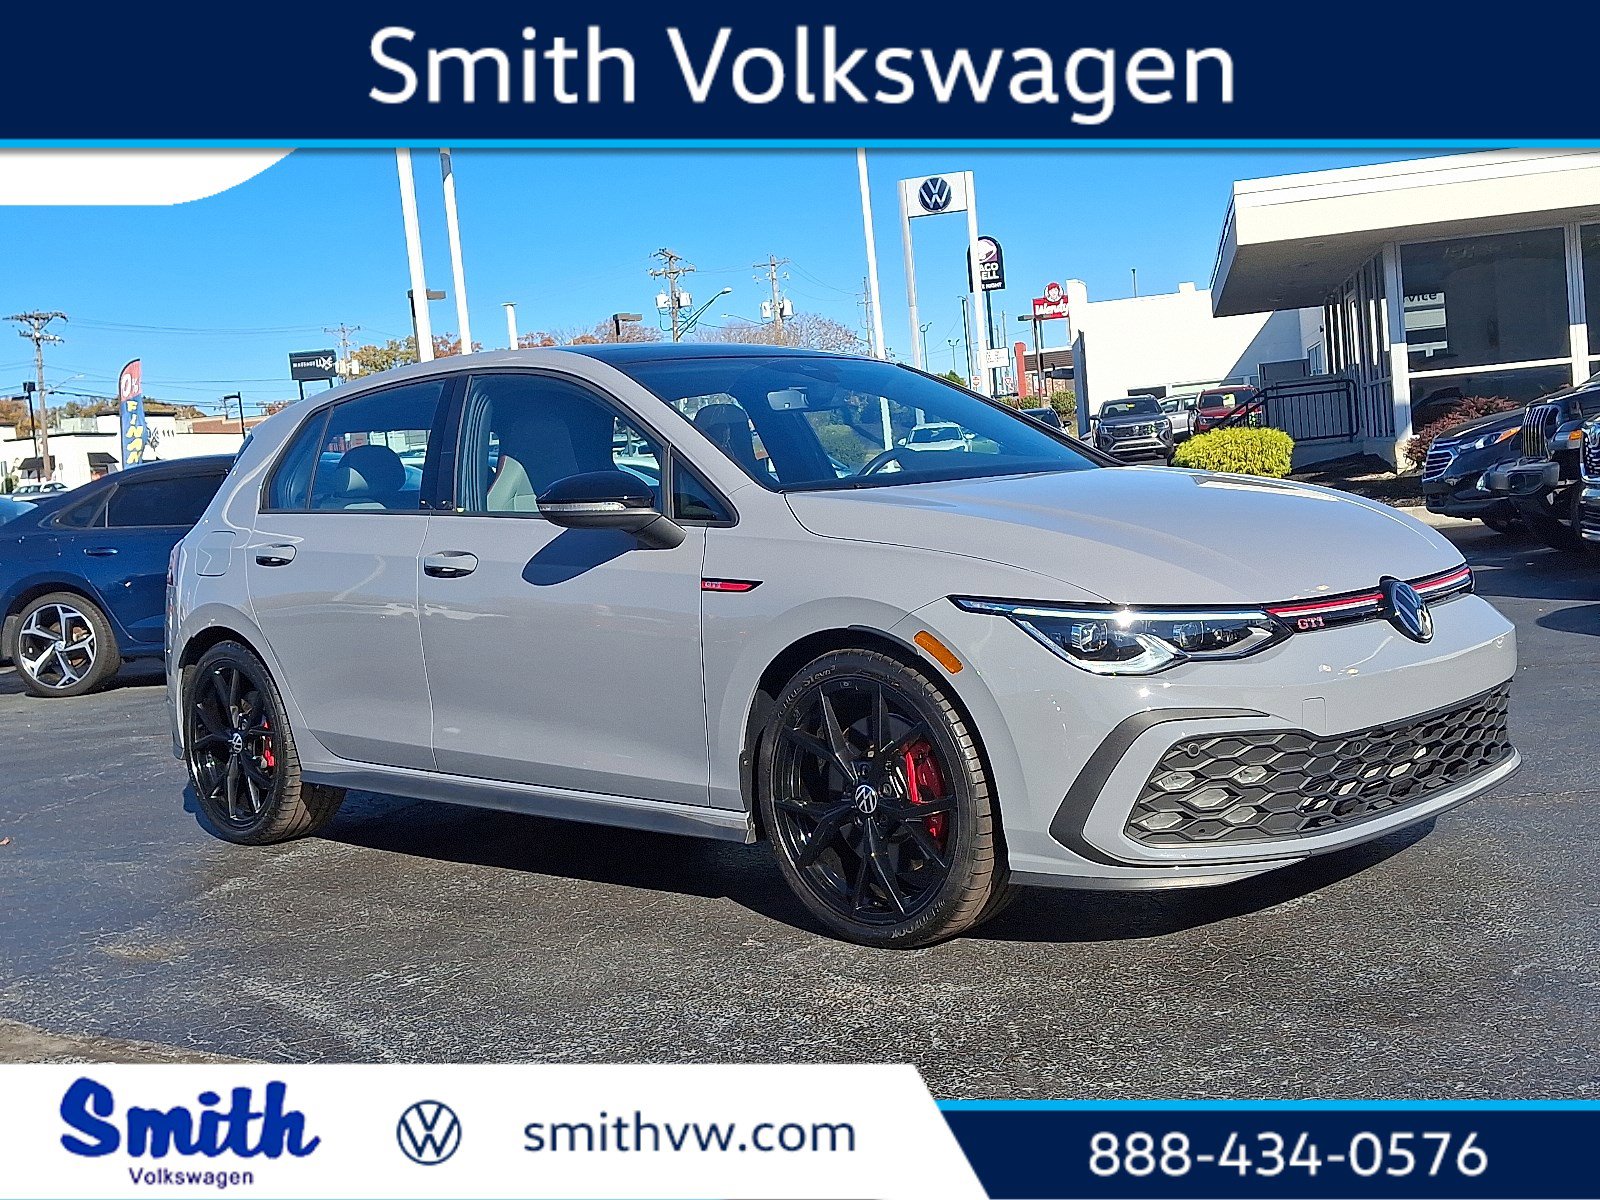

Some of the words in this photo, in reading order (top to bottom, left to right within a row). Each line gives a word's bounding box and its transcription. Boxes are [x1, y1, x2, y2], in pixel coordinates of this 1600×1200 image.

[919, 177, 952, 212] VW
[980, 262, 999, 272] ACO
[981, 270, 1000, 280] ELL
[1034, 299, 1069, 317] Wendy
[121, 373, 140, 398] 0%
[126, 400, 143, 464] FINAN
[1297, 616, 1326, 630] GTI
